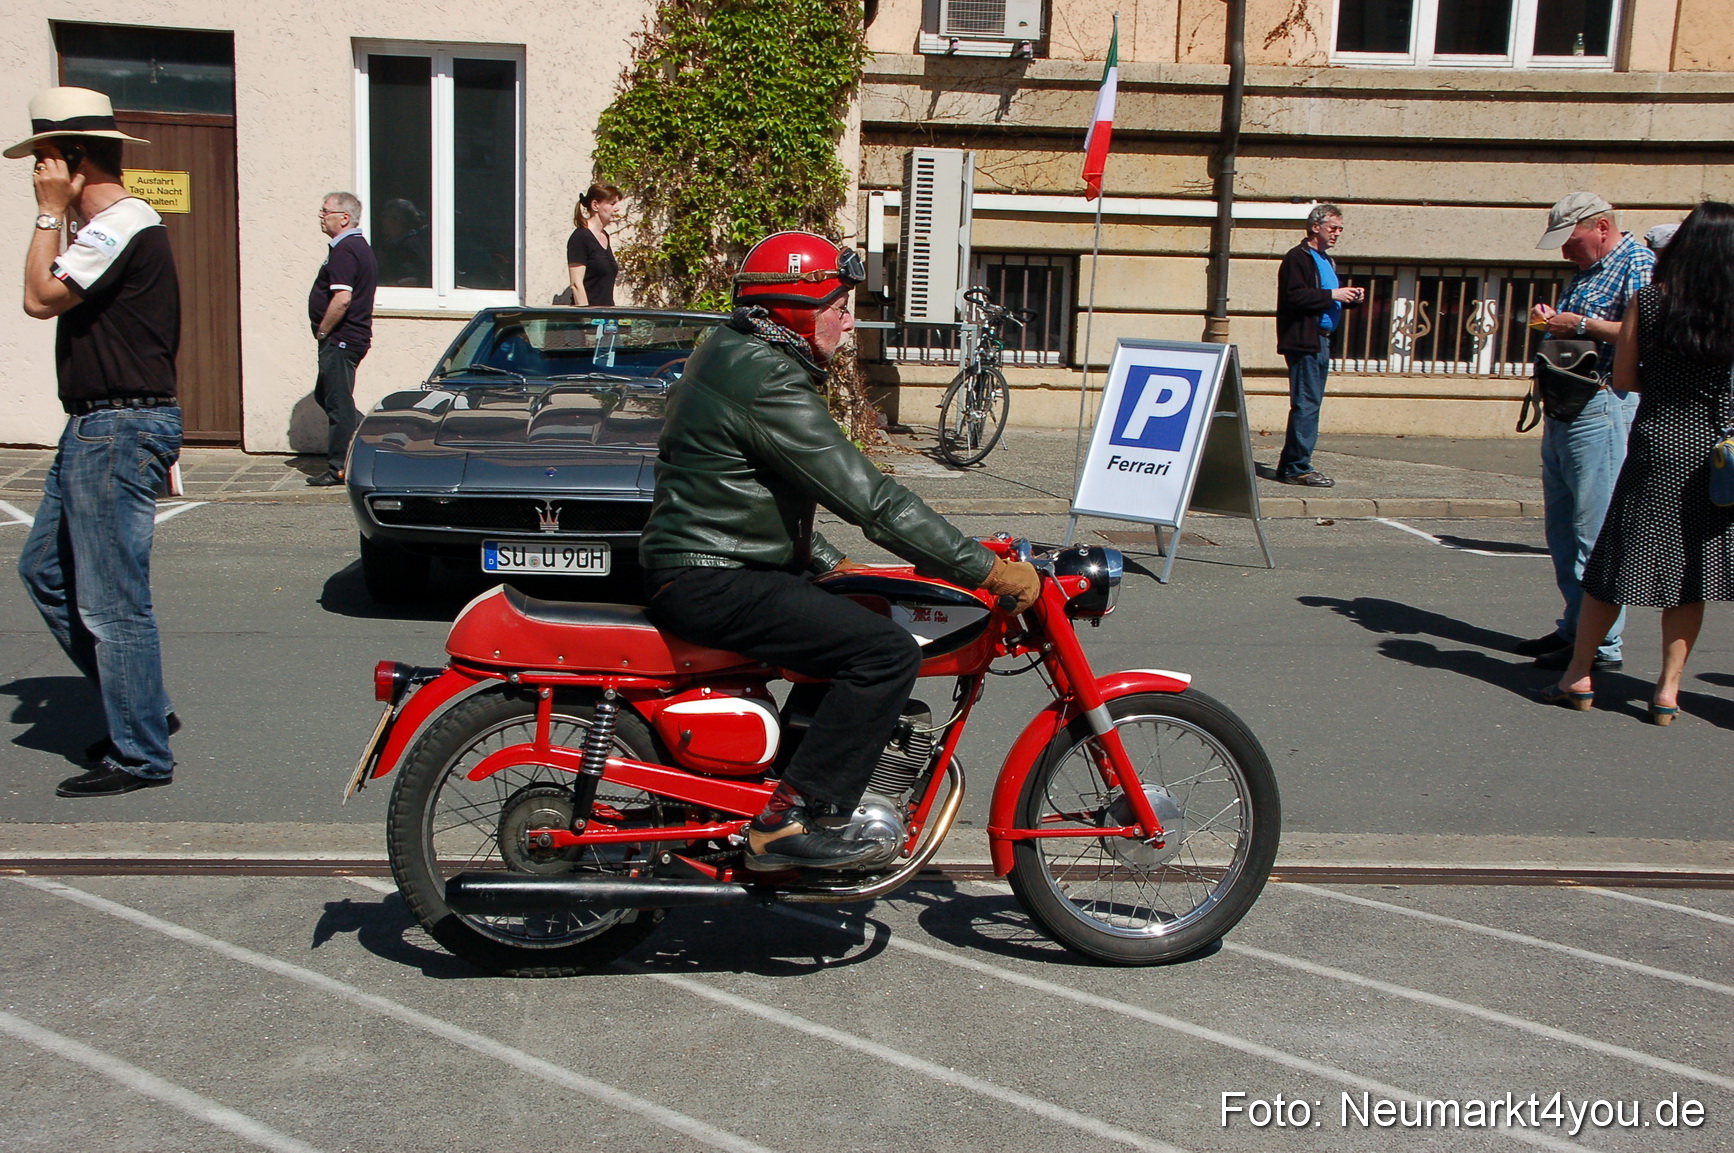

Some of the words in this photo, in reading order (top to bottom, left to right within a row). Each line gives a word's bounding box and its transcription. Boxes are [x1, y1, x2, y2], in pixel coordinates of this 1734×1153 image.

[137, 177, 174, 185] Ausfahrt
[129, 185, 144, 195] Tag
[157, 187, 182, 195] Nacht
[146, 197, 178, 206] halten!
[86, 229, 107, 241] AMD
[1121, 374, 1192, 440] P
[1107, 455, 1172, 476] Ferrari
[498, 546, 526, 567] SU
[542, 547, 556, 568] U
